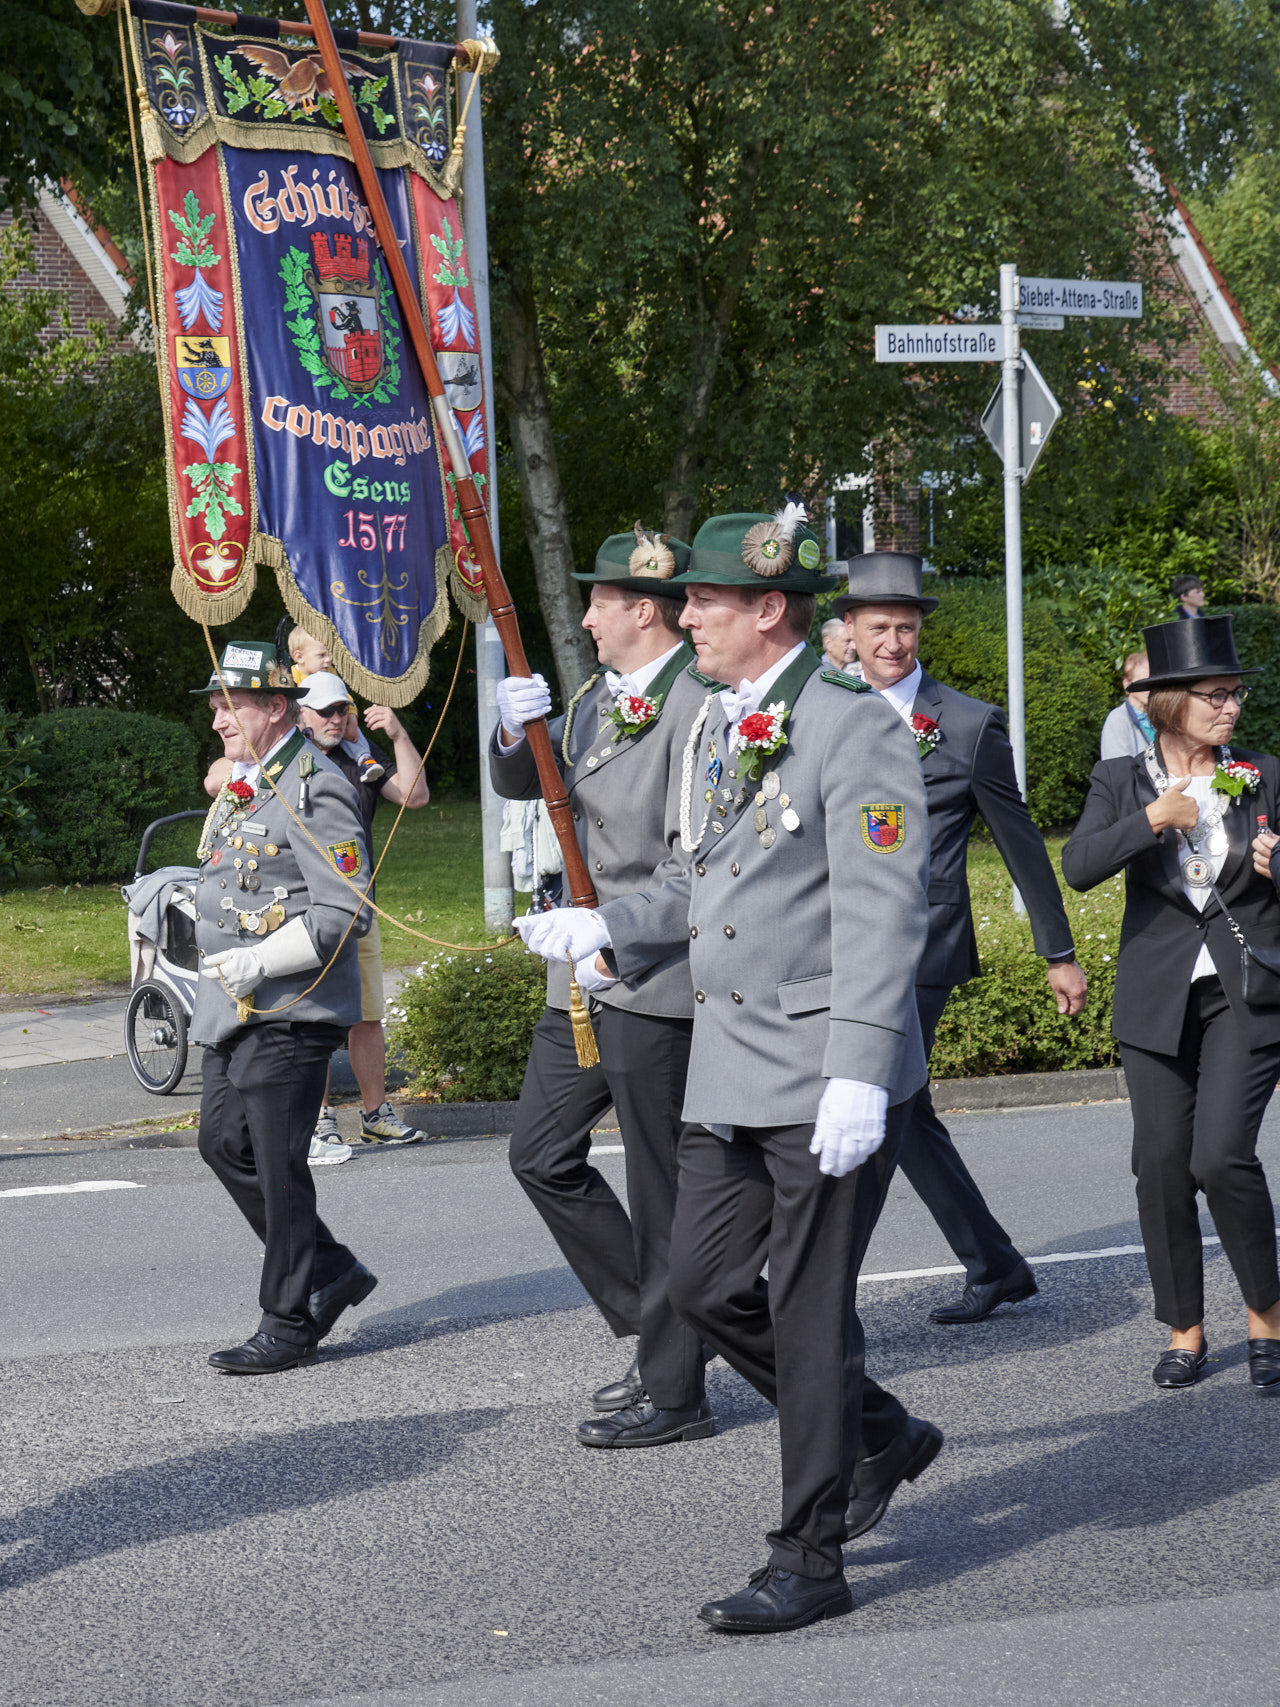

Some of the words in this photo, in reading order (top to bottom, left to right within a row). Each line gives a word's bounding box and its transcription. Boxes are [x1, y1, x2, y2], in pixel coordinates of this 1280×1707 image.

[1019, 285, 1139, 311] Siebet-Attena-Straße
[887, 332, 996, 354] Bahnhofstraße
[323, 459, 411, 506] Esens
[337, 509, 409, 553] 1577
